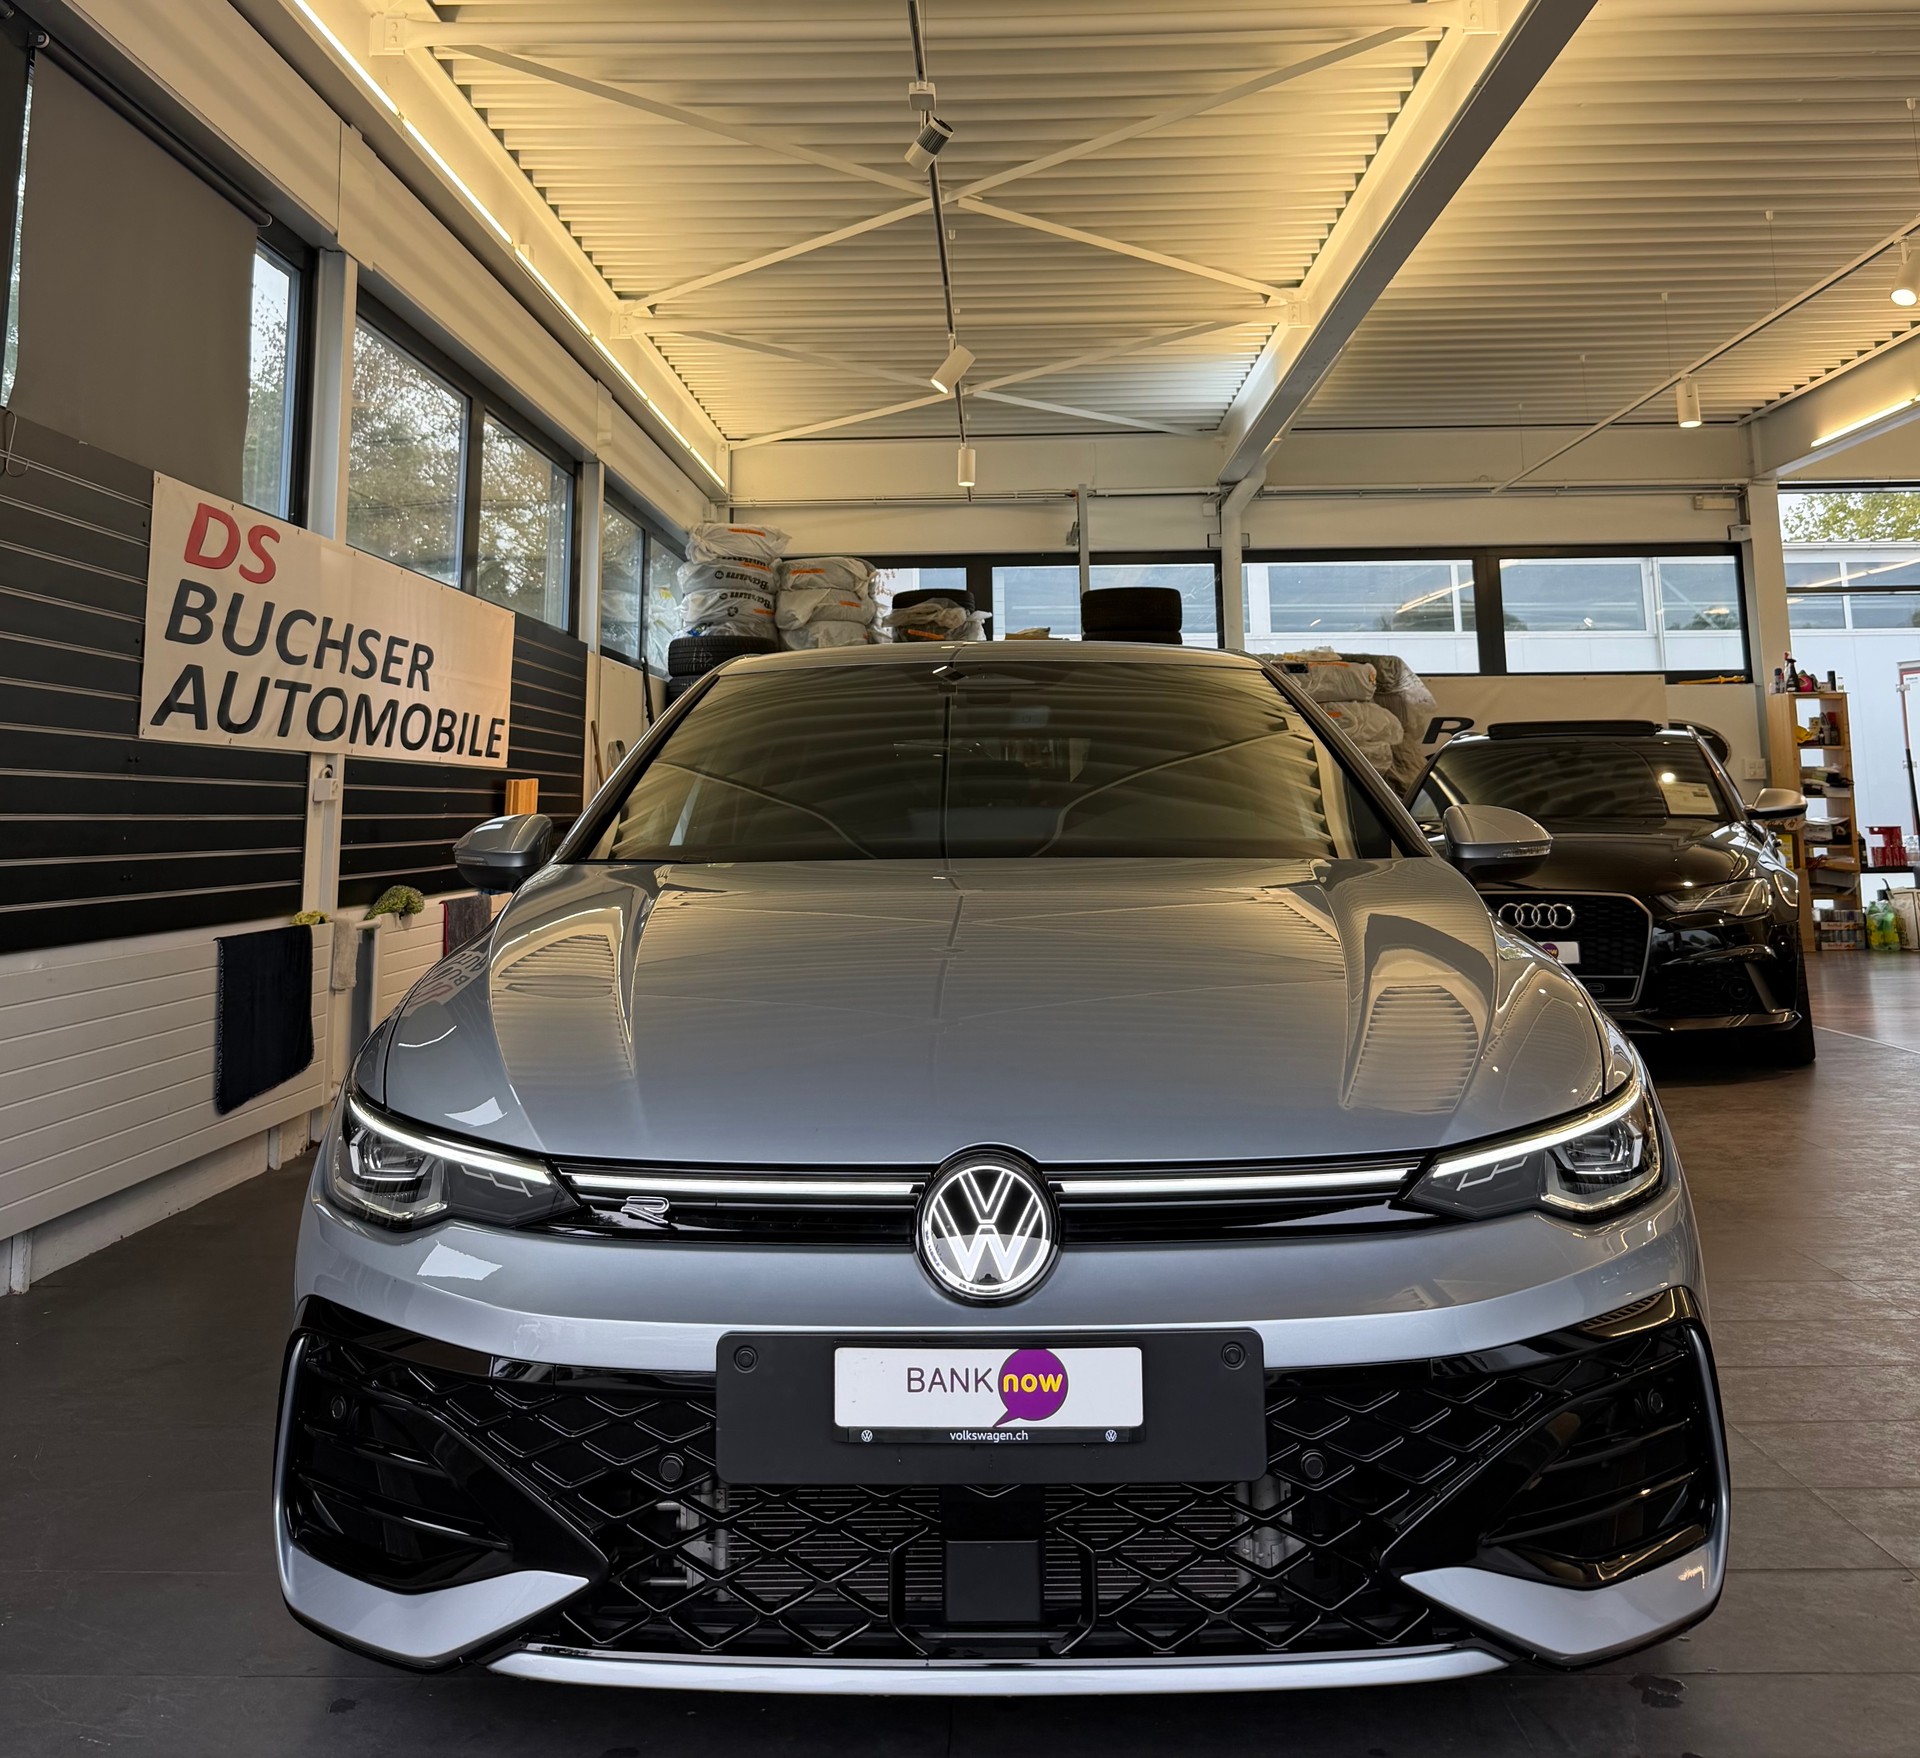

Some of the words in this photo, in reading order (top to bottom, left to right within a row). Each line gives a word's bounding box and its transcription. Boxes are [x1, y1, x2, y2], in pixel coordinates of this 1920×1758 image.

[184, 502, 280, 585] DS
[164, 578, 434, 692] BUCHSER
[150, 663, 505, 759] AUTOMOBILE
[907, 1367, 994, 1393] BANK
[1003, 1373, 1063, 1393] now
[950, 1430, 1028, 1443] volkswagen.ch
